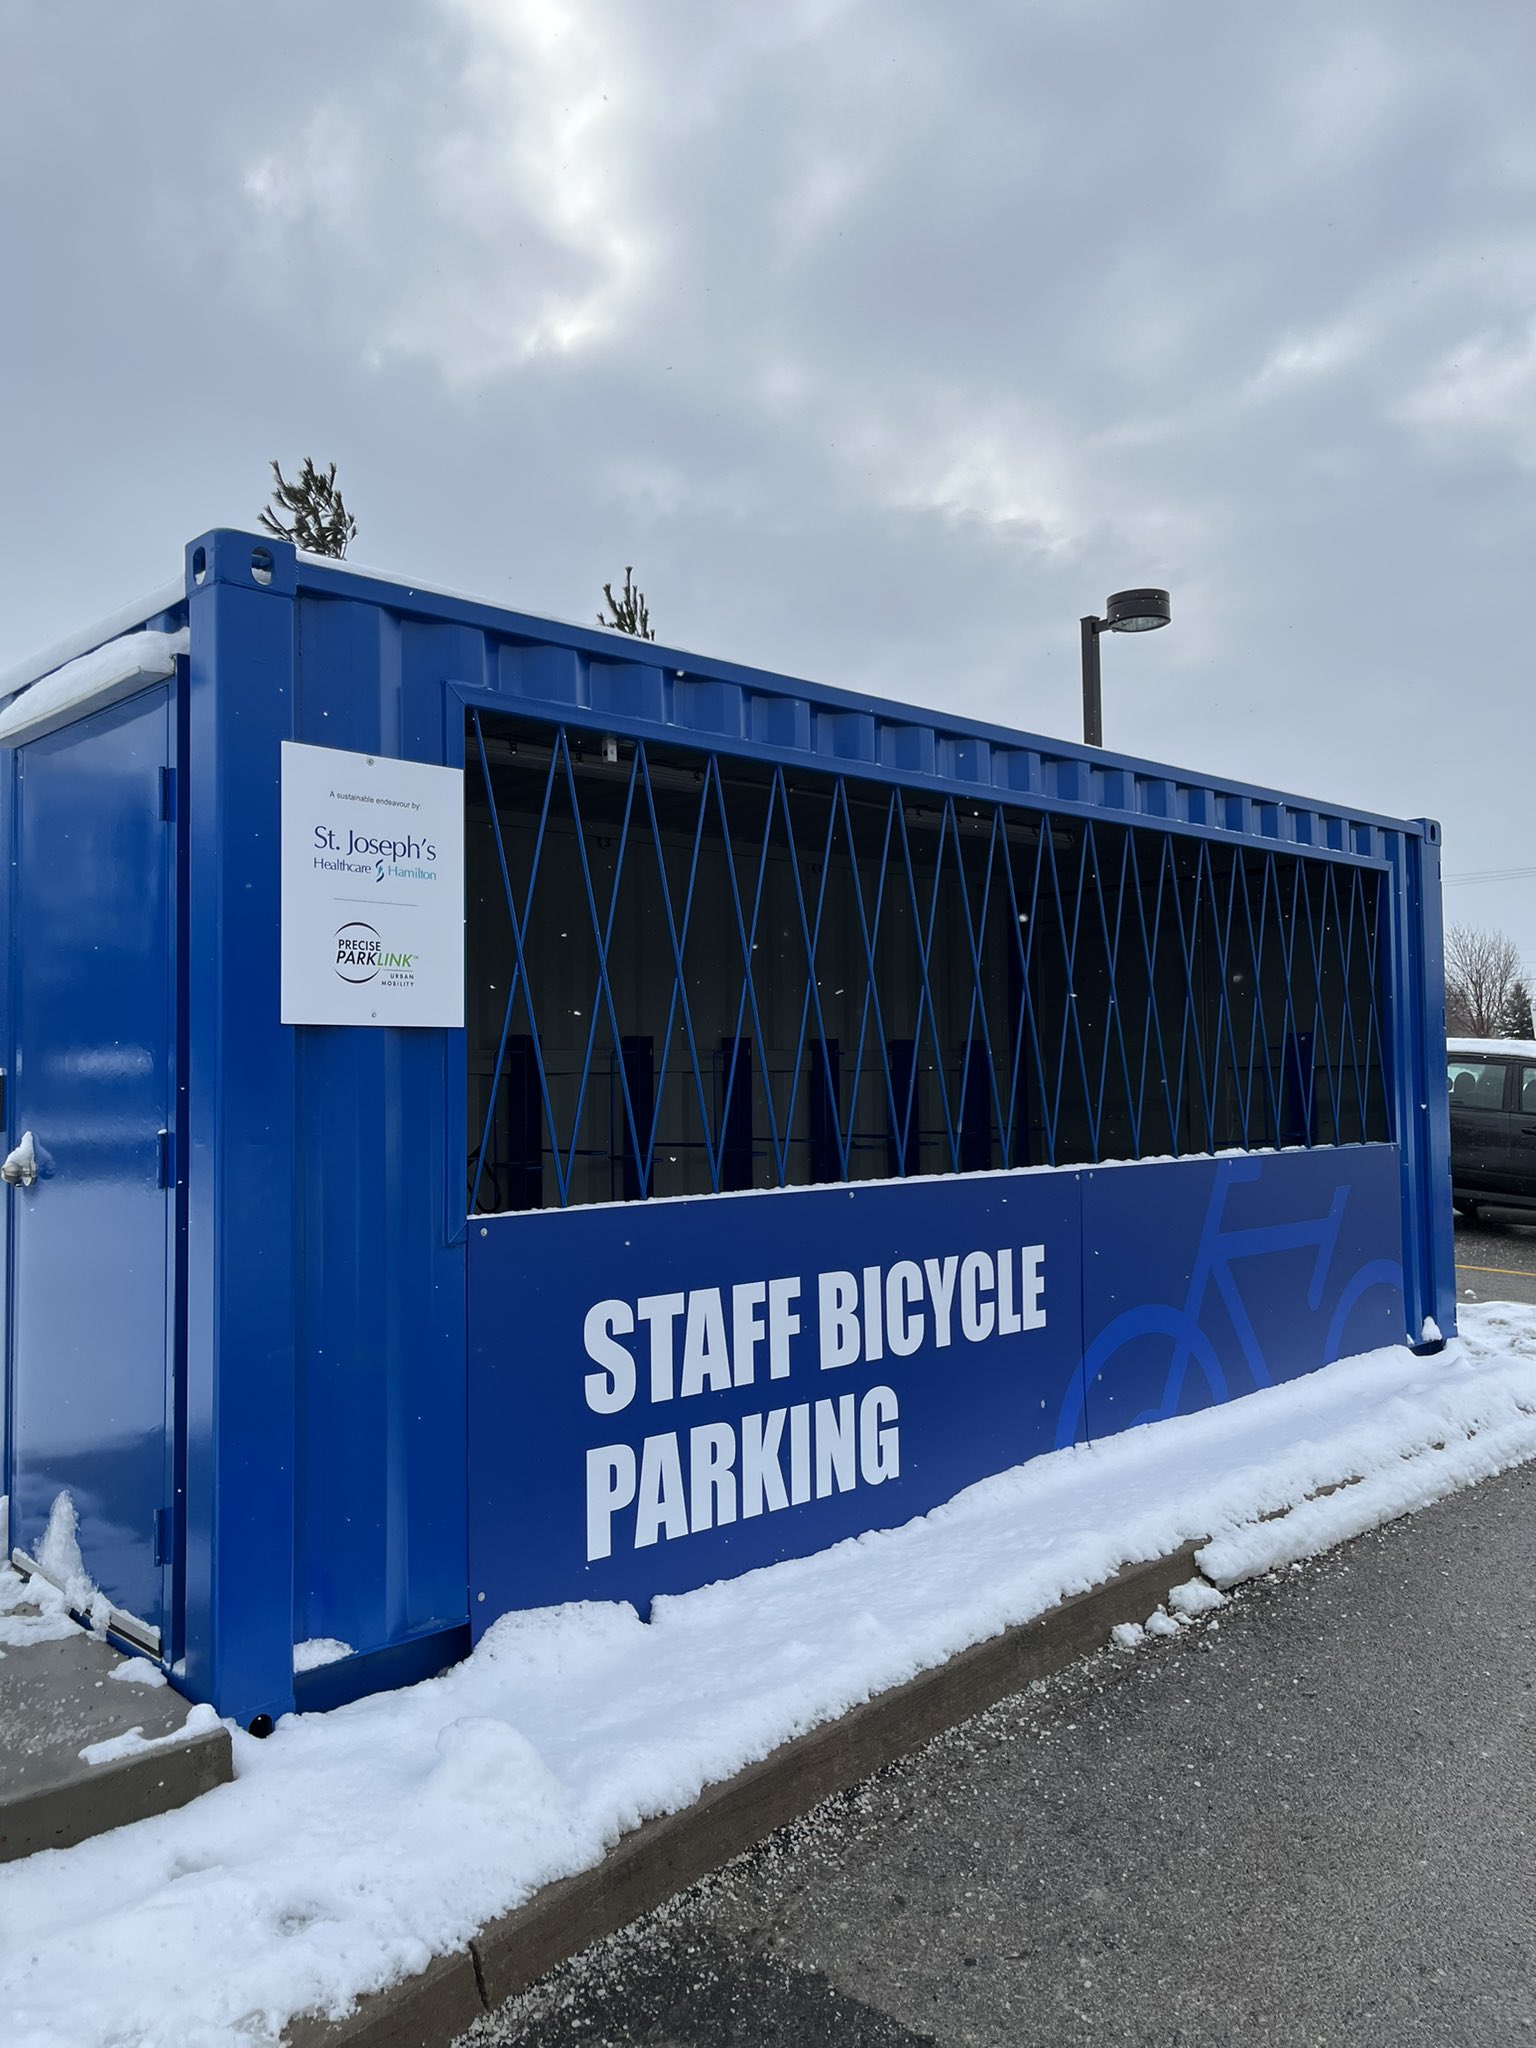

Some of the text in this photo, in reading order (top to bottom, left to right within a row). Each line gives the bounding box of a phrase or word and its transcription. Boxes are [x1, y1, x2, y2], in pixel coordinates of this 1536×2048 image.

[329, 790, 336, 798] A
[336, 792, 375, 804] sustainable
[375, 798, 411, 809] endeavour
[314, 825, 437, 863] St. Joseph's
[313, 857, 437, 881] Healthcare Hamilton
[338, 938, 382, 952] PRECISE
[381, 980, 415, 988] MOBILITY
[584, 1244, 1047, 1415] STAFF BICYCLE
[586, 1385, 900, 1562] PARKING
